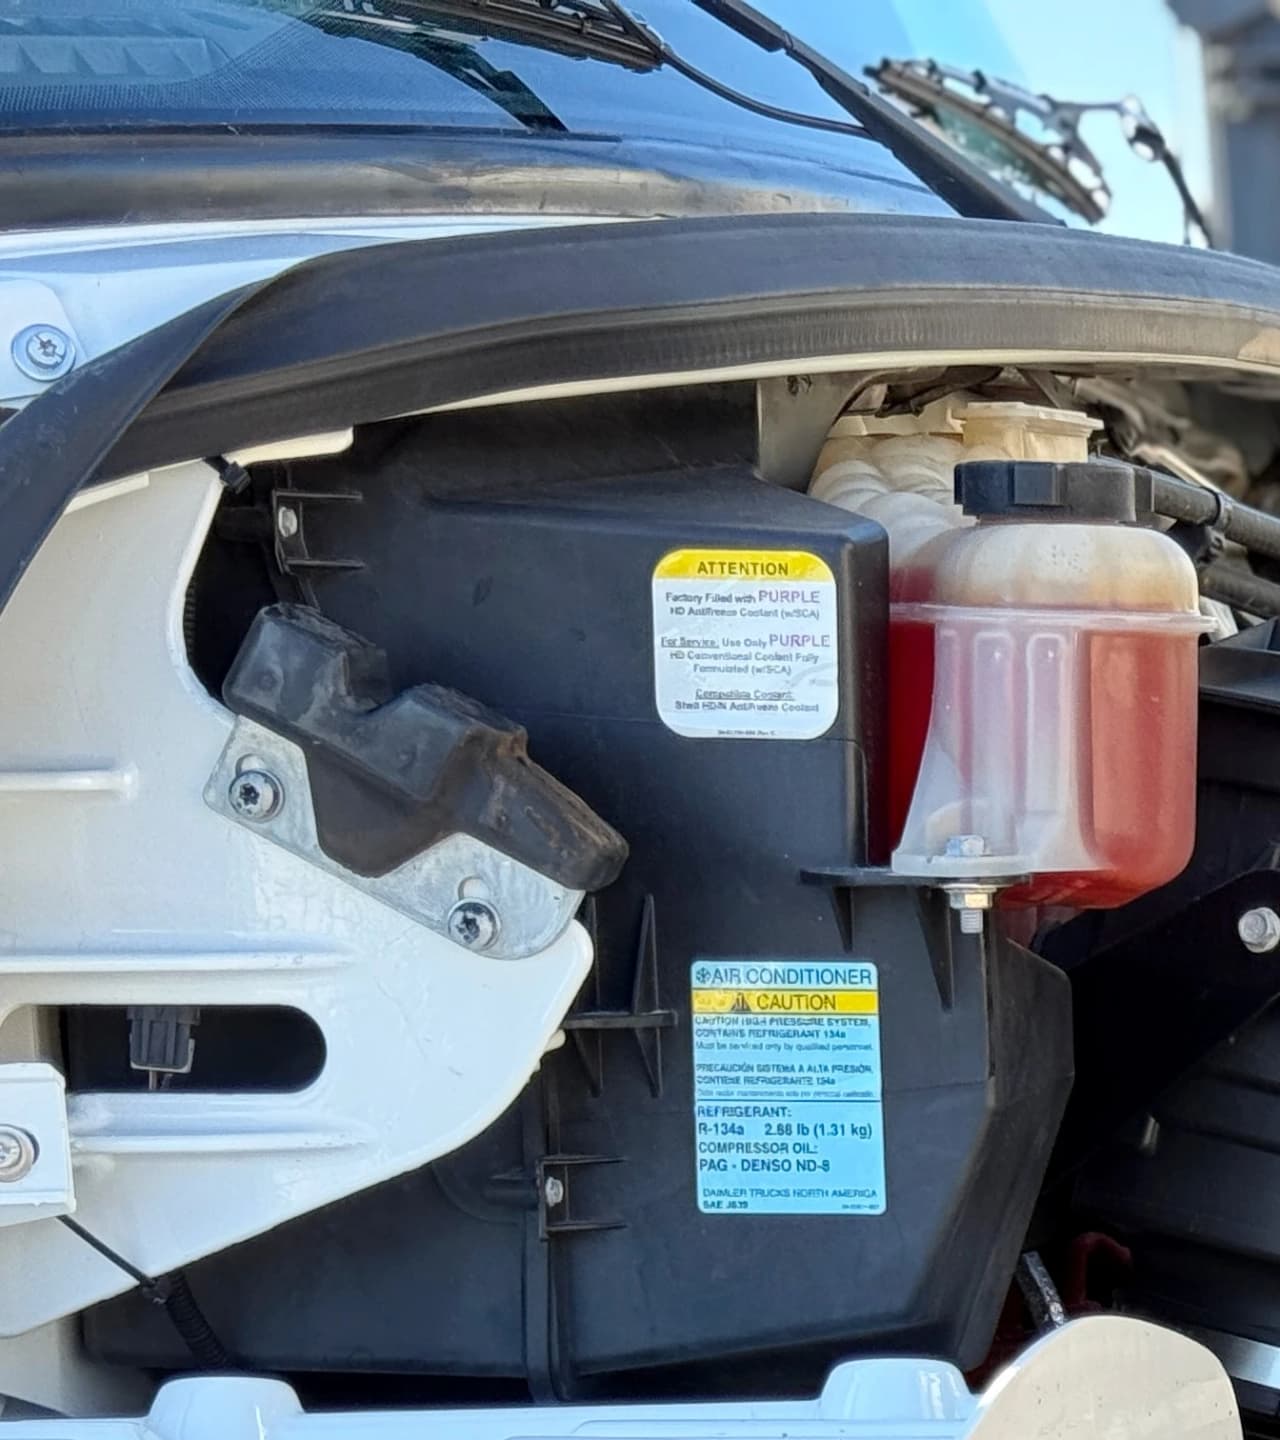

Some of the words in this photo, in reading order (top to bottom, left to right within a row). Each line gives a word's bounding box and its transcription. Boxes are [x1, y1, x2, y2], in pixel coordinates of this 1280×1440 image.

[697, 561, 788, 575] ATTENTION
[666, 592, 702, 604] Factory
[705, 593, 732, 603] Filled
[735, 593, 756, 603] with
[759, 590, 820, 603] PURPLE
[670, 607, 685, 616] HD
[661, 637, 678, 648] For
[722, 638, 741, 647] Use
[744, 638, 767, 649] Only
[769, 634, 830, 647] PURPLE
[670, 652, 685, 660] HD
[688, 651, 752, 660] Conventional
[675, 701, 700, 710] Shell
[711, 968, 741, 985] AIR
[745, 968, 872, 985] CONDITIONER
[756, 994, 837, 1011] CAUTION
[695, 1017, 738, 1026] CAUTION
[769, 1018, 824, 1026] PRESSURE
[695, 1030, 745, 1038] CONTAINS
[748, 1030, 820, 1038] REFRIGERANT
[823, 1030, 846, 1038] 134a
[756, 1064, 795, 1073] SISTEMA
[798, 1064, 804, 1073] A
[807, 1064, 829, 1073] ALTA
[697, 1106, 792, 1118] REFRIGERANT:
[698, 1123, 744, 1136] R-134a
[797, 1123, 810, 1136] lb
[814, 1124, 846, 1138] (1.31
[850, 1123, 872, 1139] kg)
[699, 1142, 789, 1154] COMPRESSOR
[792, 1142, 818, 1154] OIL:
[699, 1159, 728, 1171] PAG
[741, 1159, 792, 1172] DENSO
[703, 1189, 747, 1197] DAIMLER
[750, 1189, 791, 1197] TRUCKS
[793, 1189, 829, 1197] NORTH
[831, 1189, 877, 1198] AMERICA
[703, 1201, 724, 1209] SAE
